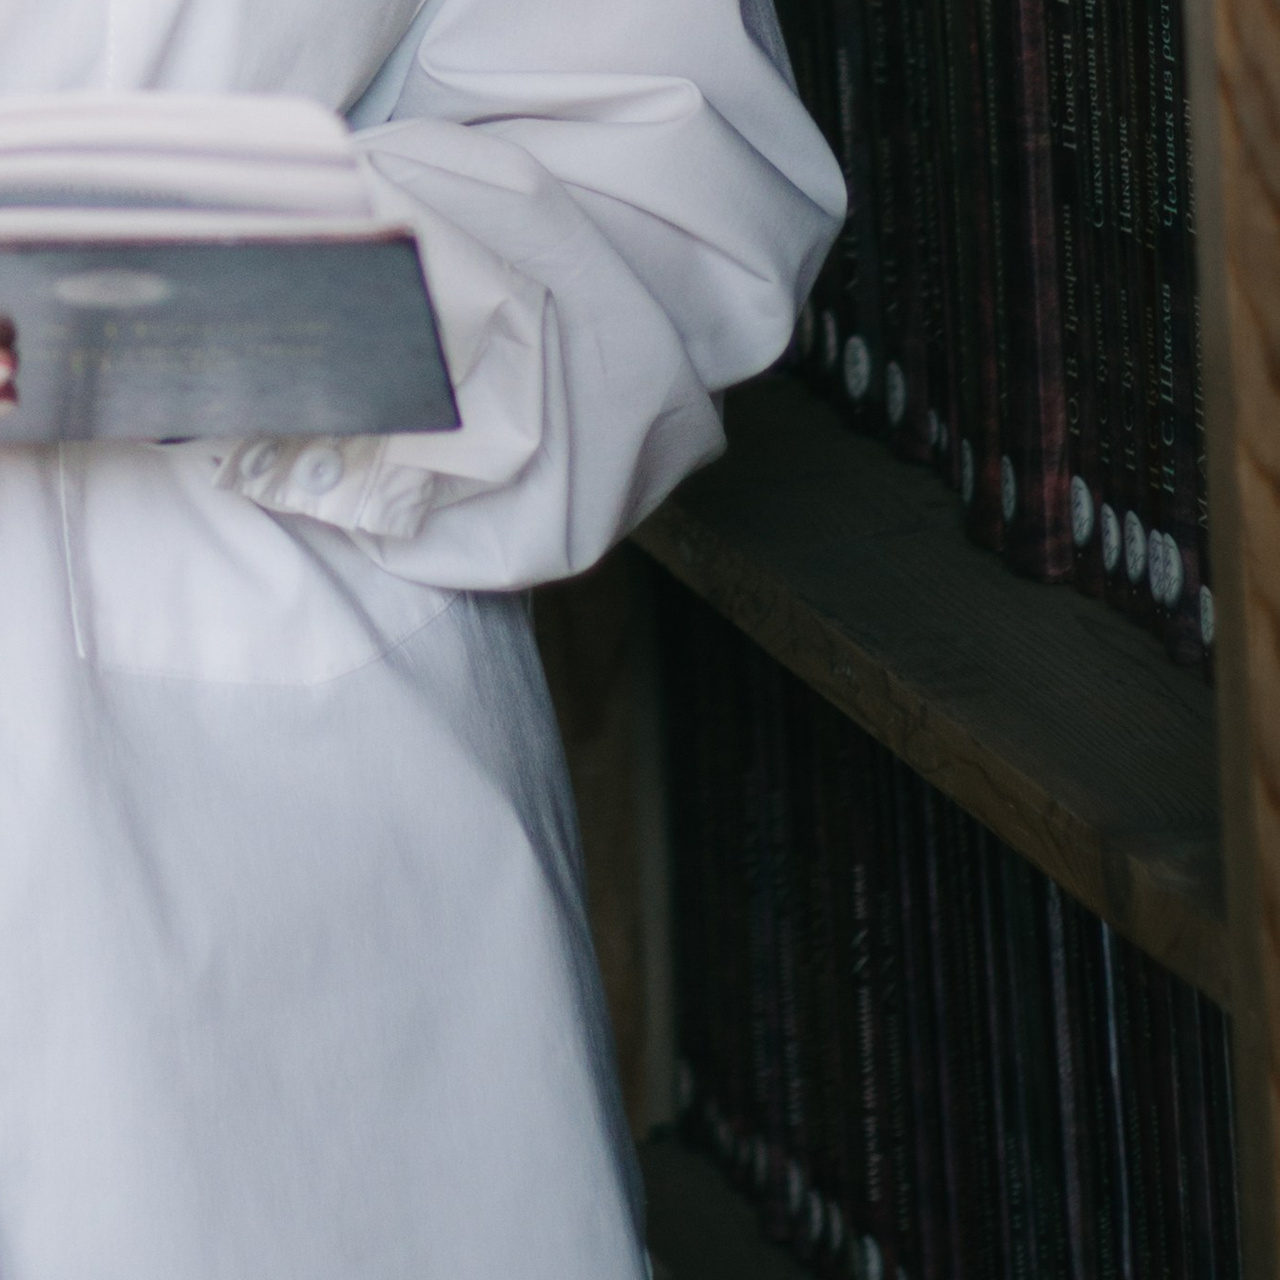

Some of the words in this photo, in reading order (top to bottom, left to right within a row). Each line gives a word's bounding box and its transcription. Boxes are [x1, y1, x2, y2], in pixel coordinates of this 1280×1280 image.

[1061, 33, 1078, 152] Повести
[1161, 69, 1174, 101] из
[1117, 114, 1134, 235] Накануне
[1163, 110, 1179, 228] Человек
[1062, 203, 1079, 338] Трифонов
[1160, 282, 1175, 405] Шмелев
[1160, 415, 1175, 447] С.
[1162, 460, 1176, 495] И.
